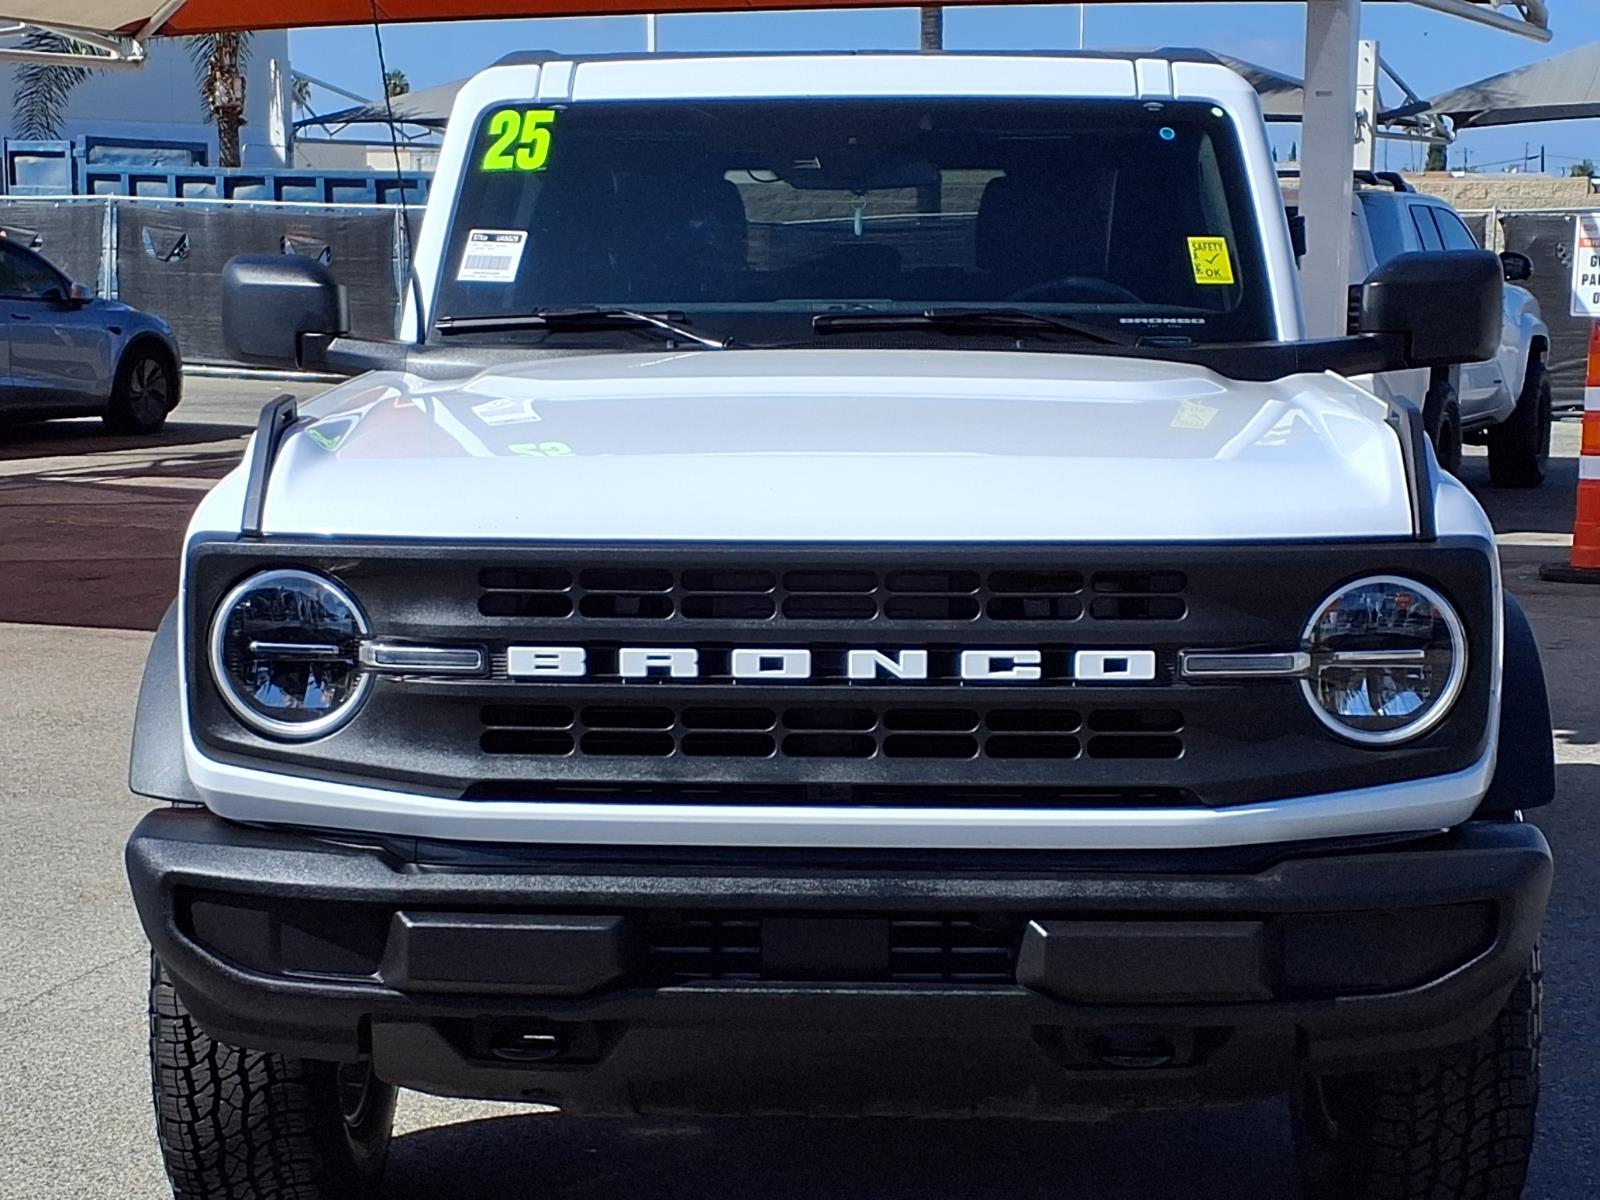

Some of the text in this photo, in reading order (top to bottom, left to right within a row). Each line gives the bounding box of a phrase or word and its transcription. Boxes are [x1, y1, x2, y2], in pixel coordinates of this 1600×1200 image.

[483, 109, 555, 170] 25
[1191, 241, 1223, 252] SAFETY
[1205, 268, 1222, 278] OK
[507, 645, 1156, 680] BRONCO
